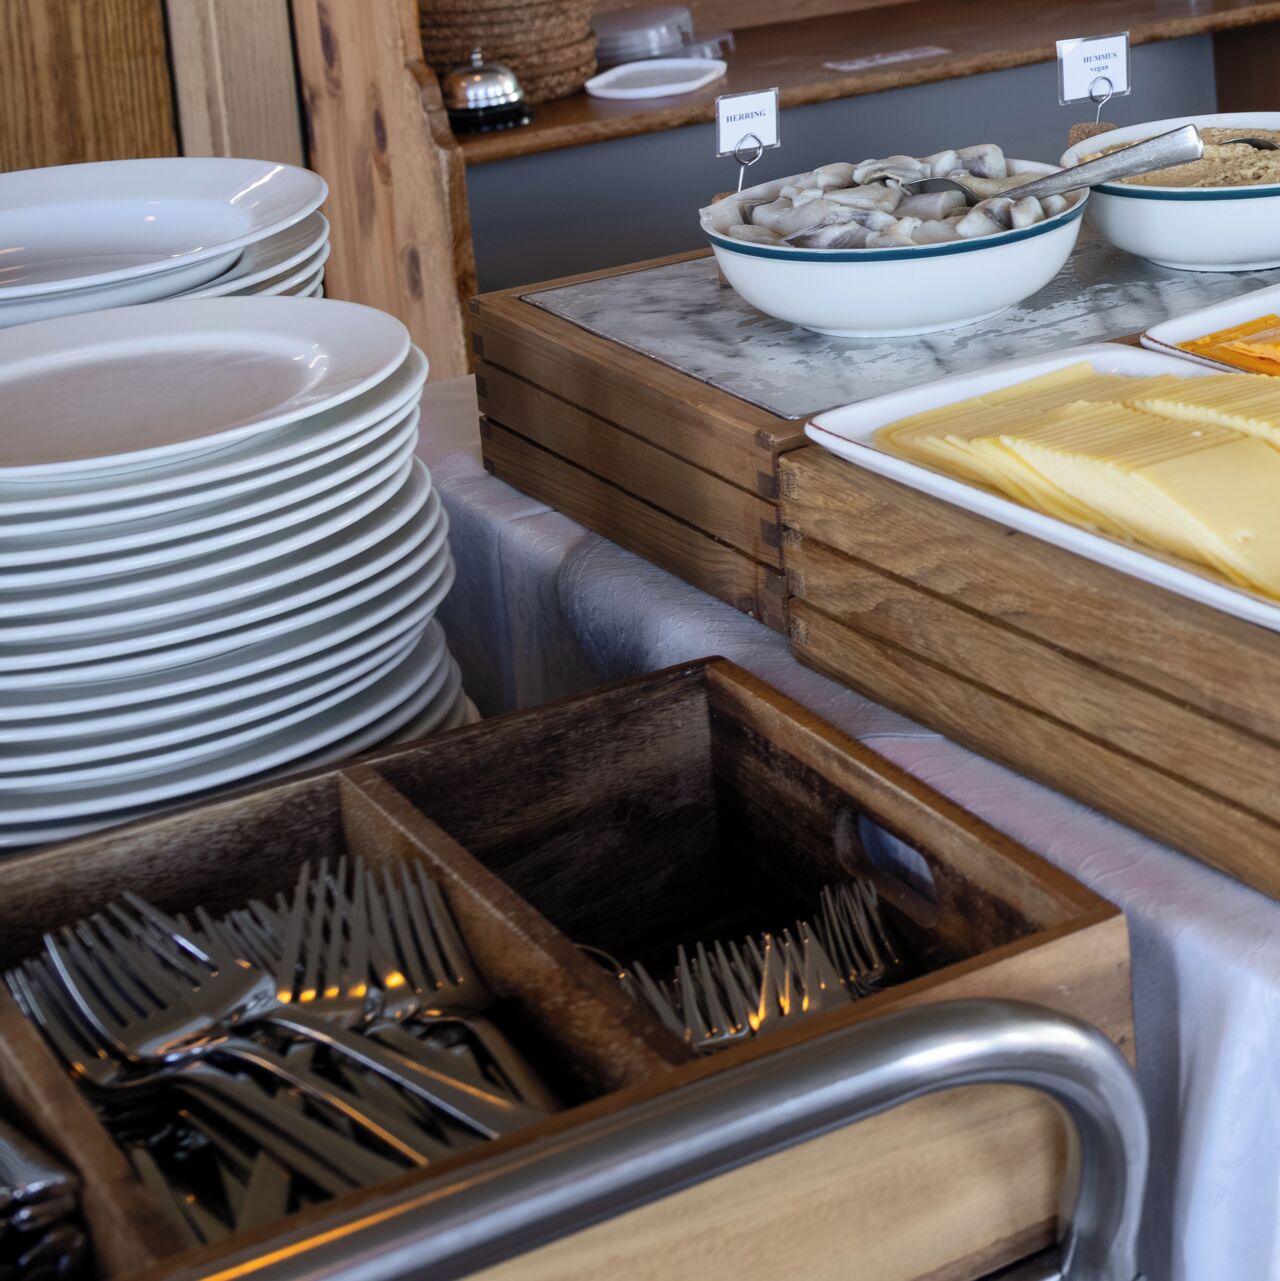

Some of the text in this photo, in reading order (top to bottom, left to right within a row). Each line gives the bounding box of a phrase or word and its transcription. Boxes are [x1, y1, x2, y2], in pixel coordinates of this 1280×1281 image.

[1082, 51, 1118, 64] HUMMUS
[1090, 65, 1109, 73] vegan
[726, 109, 766, 123] HERRING
